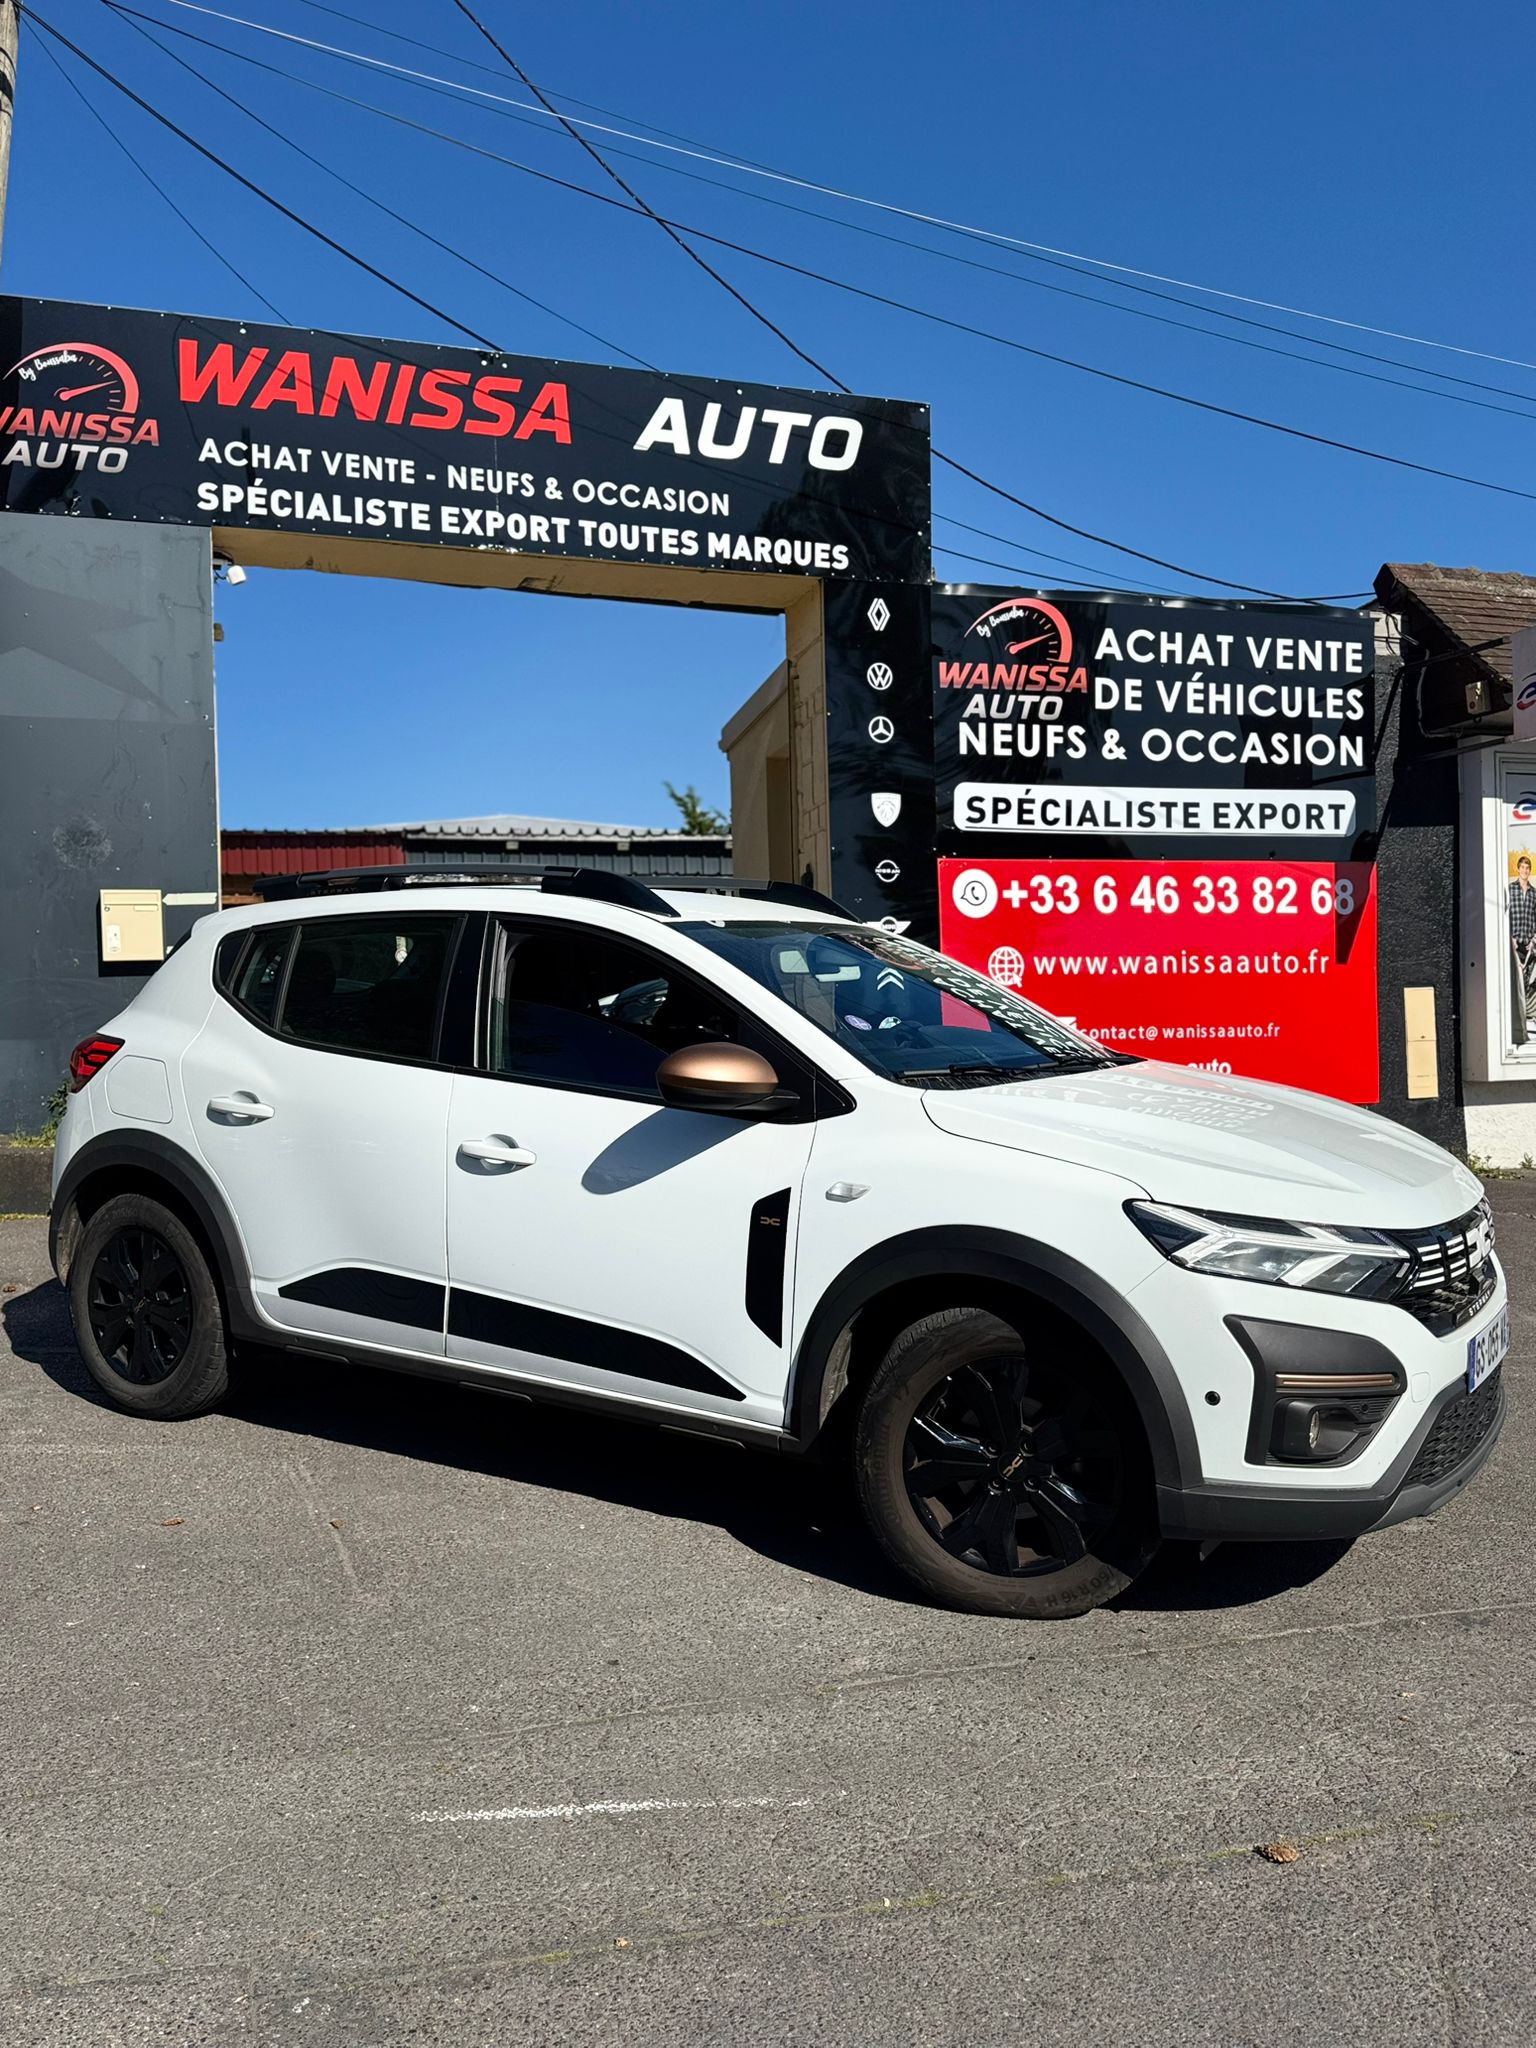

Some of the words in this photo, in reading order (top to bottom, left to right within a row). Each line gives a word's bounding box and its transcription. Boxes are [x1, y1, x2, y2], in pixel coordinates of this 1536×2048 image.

[178, 338, 572, 445] WANISSA
[633, 397, 864, 472] AUTO
[1, 439, 129, 474] AUTO
[198, 437, 312, 473] ACHAT
[322, 451, 415, 485] VENTE
[448, 464, 536, 498] NEUFS
[544, 479, 564, 501] &
[572, 479, 730, 517] OCCASION
[197, 478, 431, 531] SPÉCIALISTE
[441, 506, 570, 544] EXPORT
[578, 519, 699, 556] TOUTES
[708, 532, 850, 570] MARQUES
[1095, 627, 1234, 667] ACHAT
[1246, 637, 1364, 674] VENTE
[939, 661, 1089, 694] WANISSA
[1095, 677, 1143, 712] DE
[1155, 671, 1365, 721] VÉHICULES
[963, 693, 1063, 720] AUTO
[958, 721, 1087, 759] NEUFS
[1101, 729, 1128, 760] &
[1141, 729, 1364, 767] OCCASION
[966, 788, 1201, 829] SPÉCIALISTE
[1213, 803, 1347, 830] EXPORT
[1003, 874, 1080, 915] +33
[1094, 875, 1118, 915] 6
[1130, 875, 1180, 915] 46
[1193, 876, 1240, 915] 33
[1253, 876, 1298, 915] 82
[1310, 877, 1354, 916] 68
[1034, 948, 1329, 975] www.wanissaauto.fr
